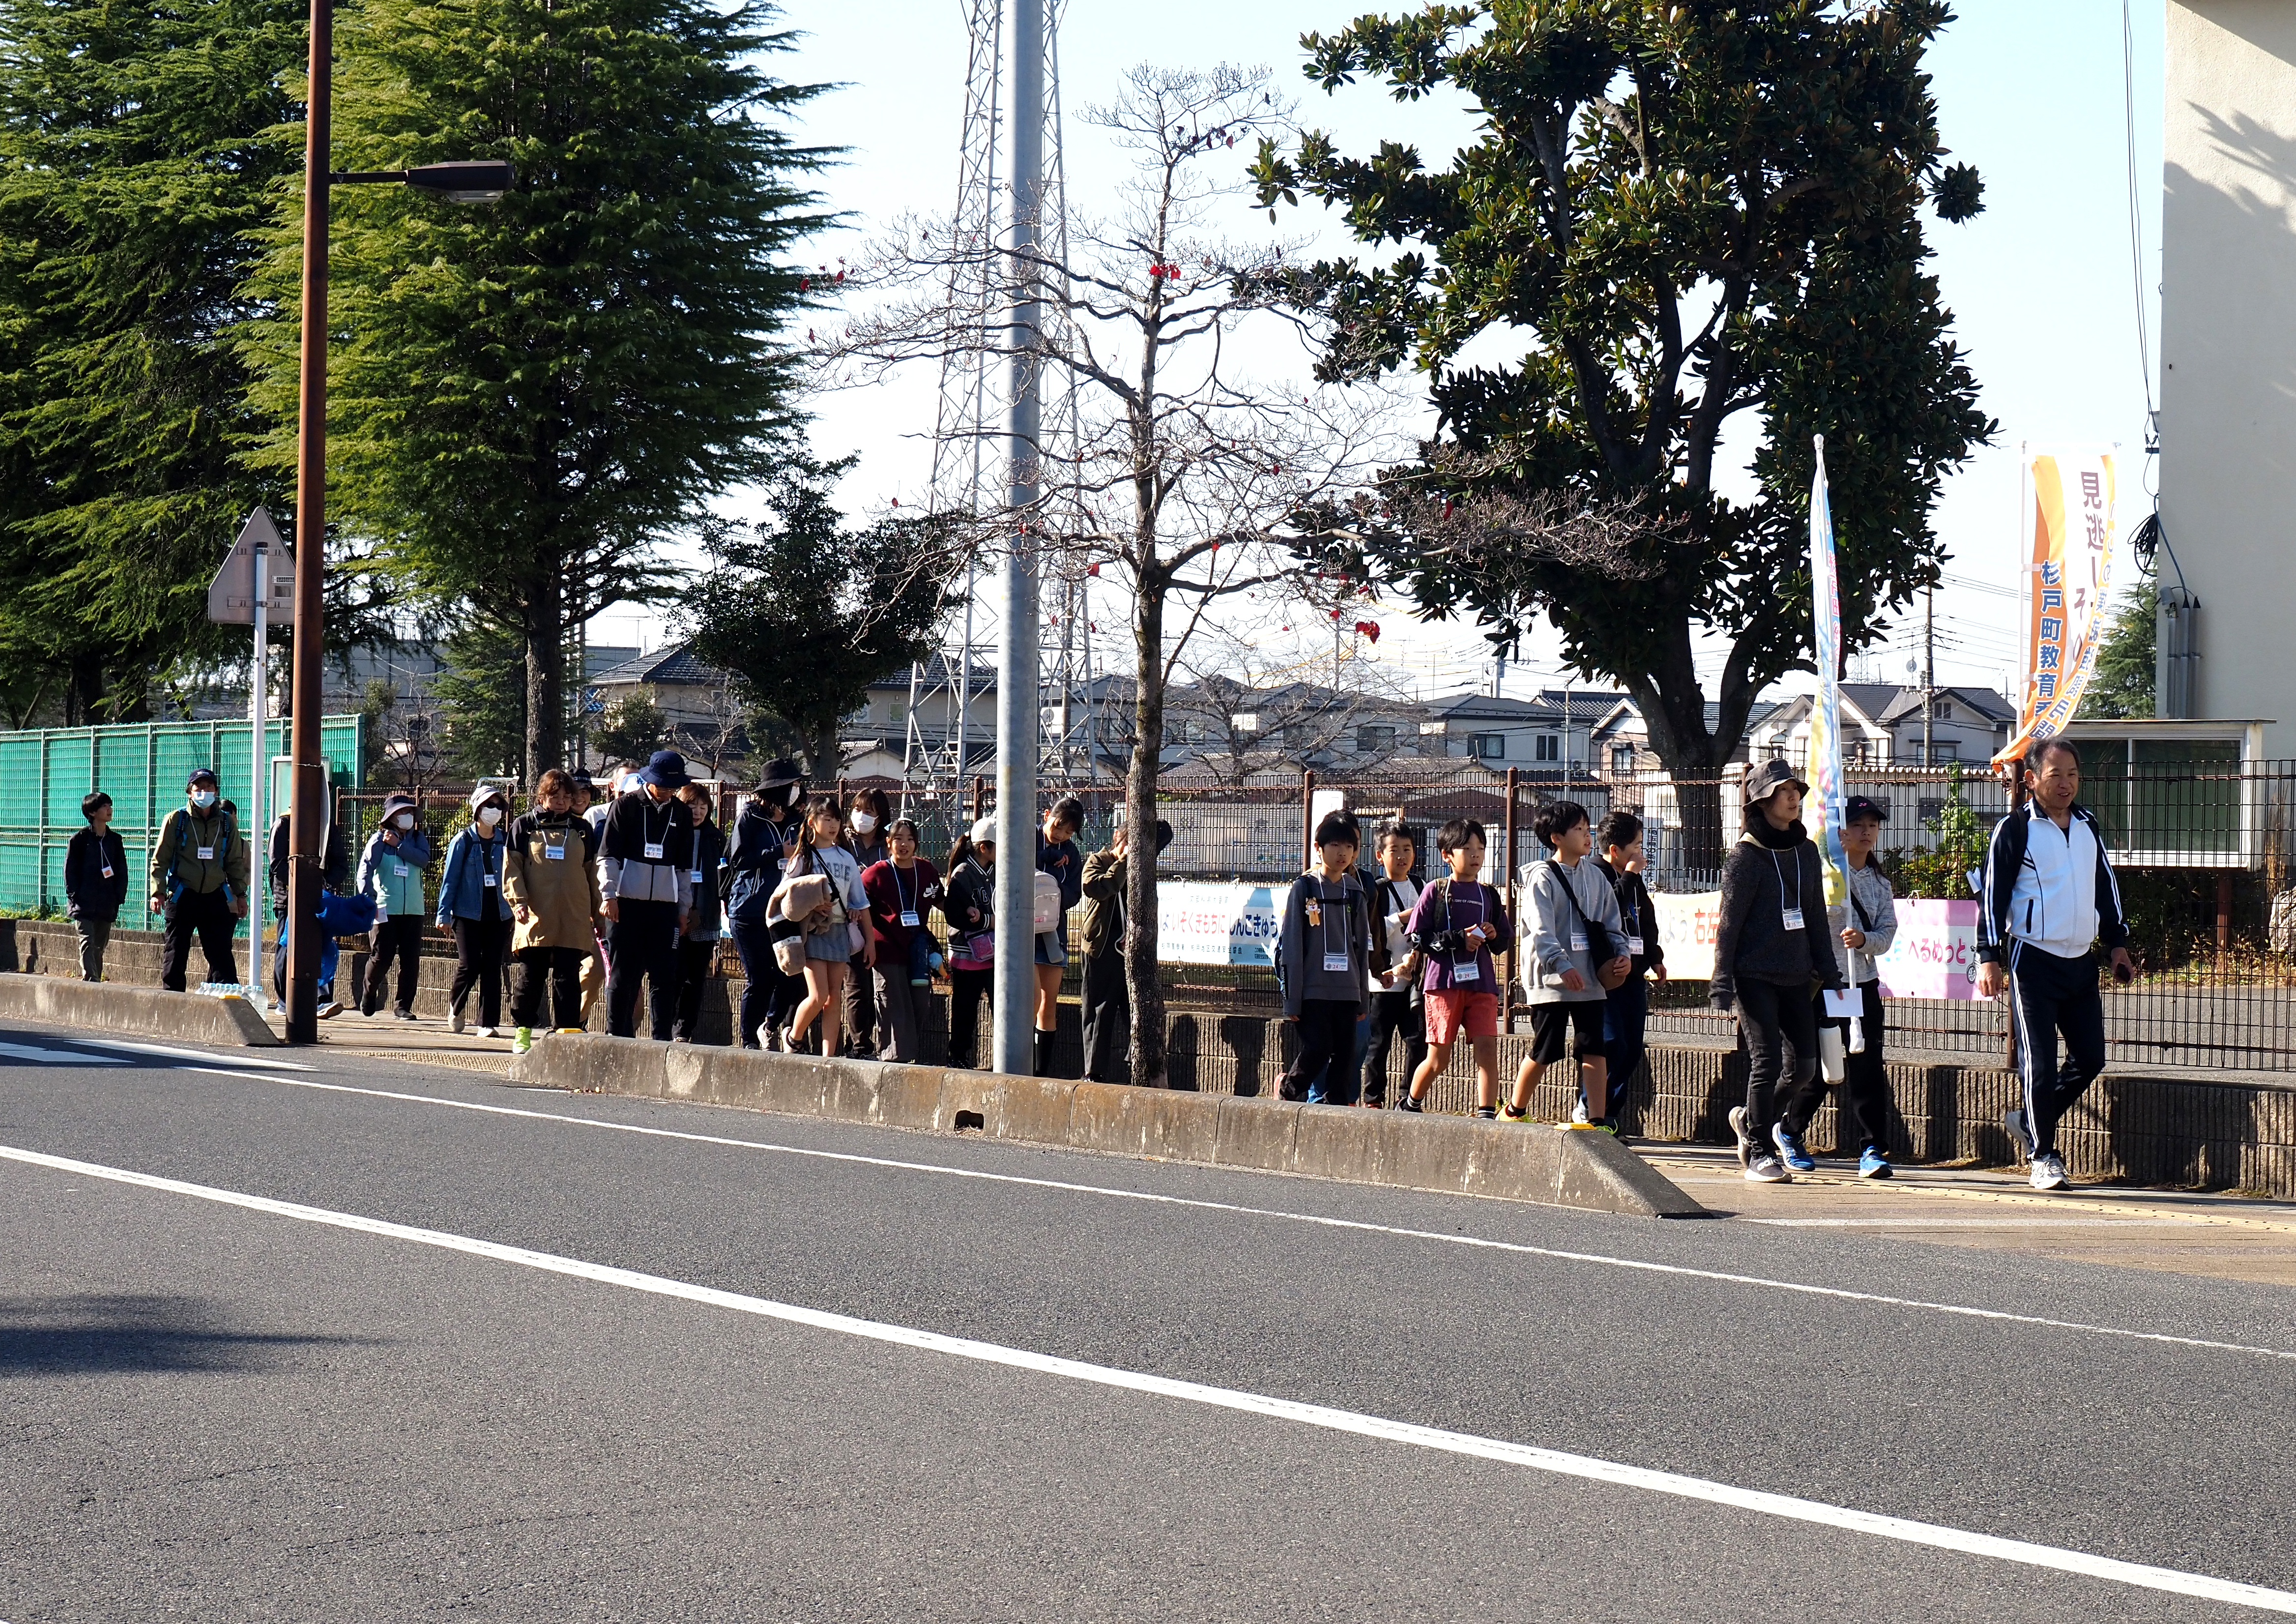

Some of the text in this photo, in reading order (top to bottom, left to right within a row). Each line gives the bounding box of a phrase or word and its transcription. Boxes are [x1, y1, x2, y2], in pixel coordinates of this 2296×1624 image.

[1908, 937, 1966, 965] へるめっと
